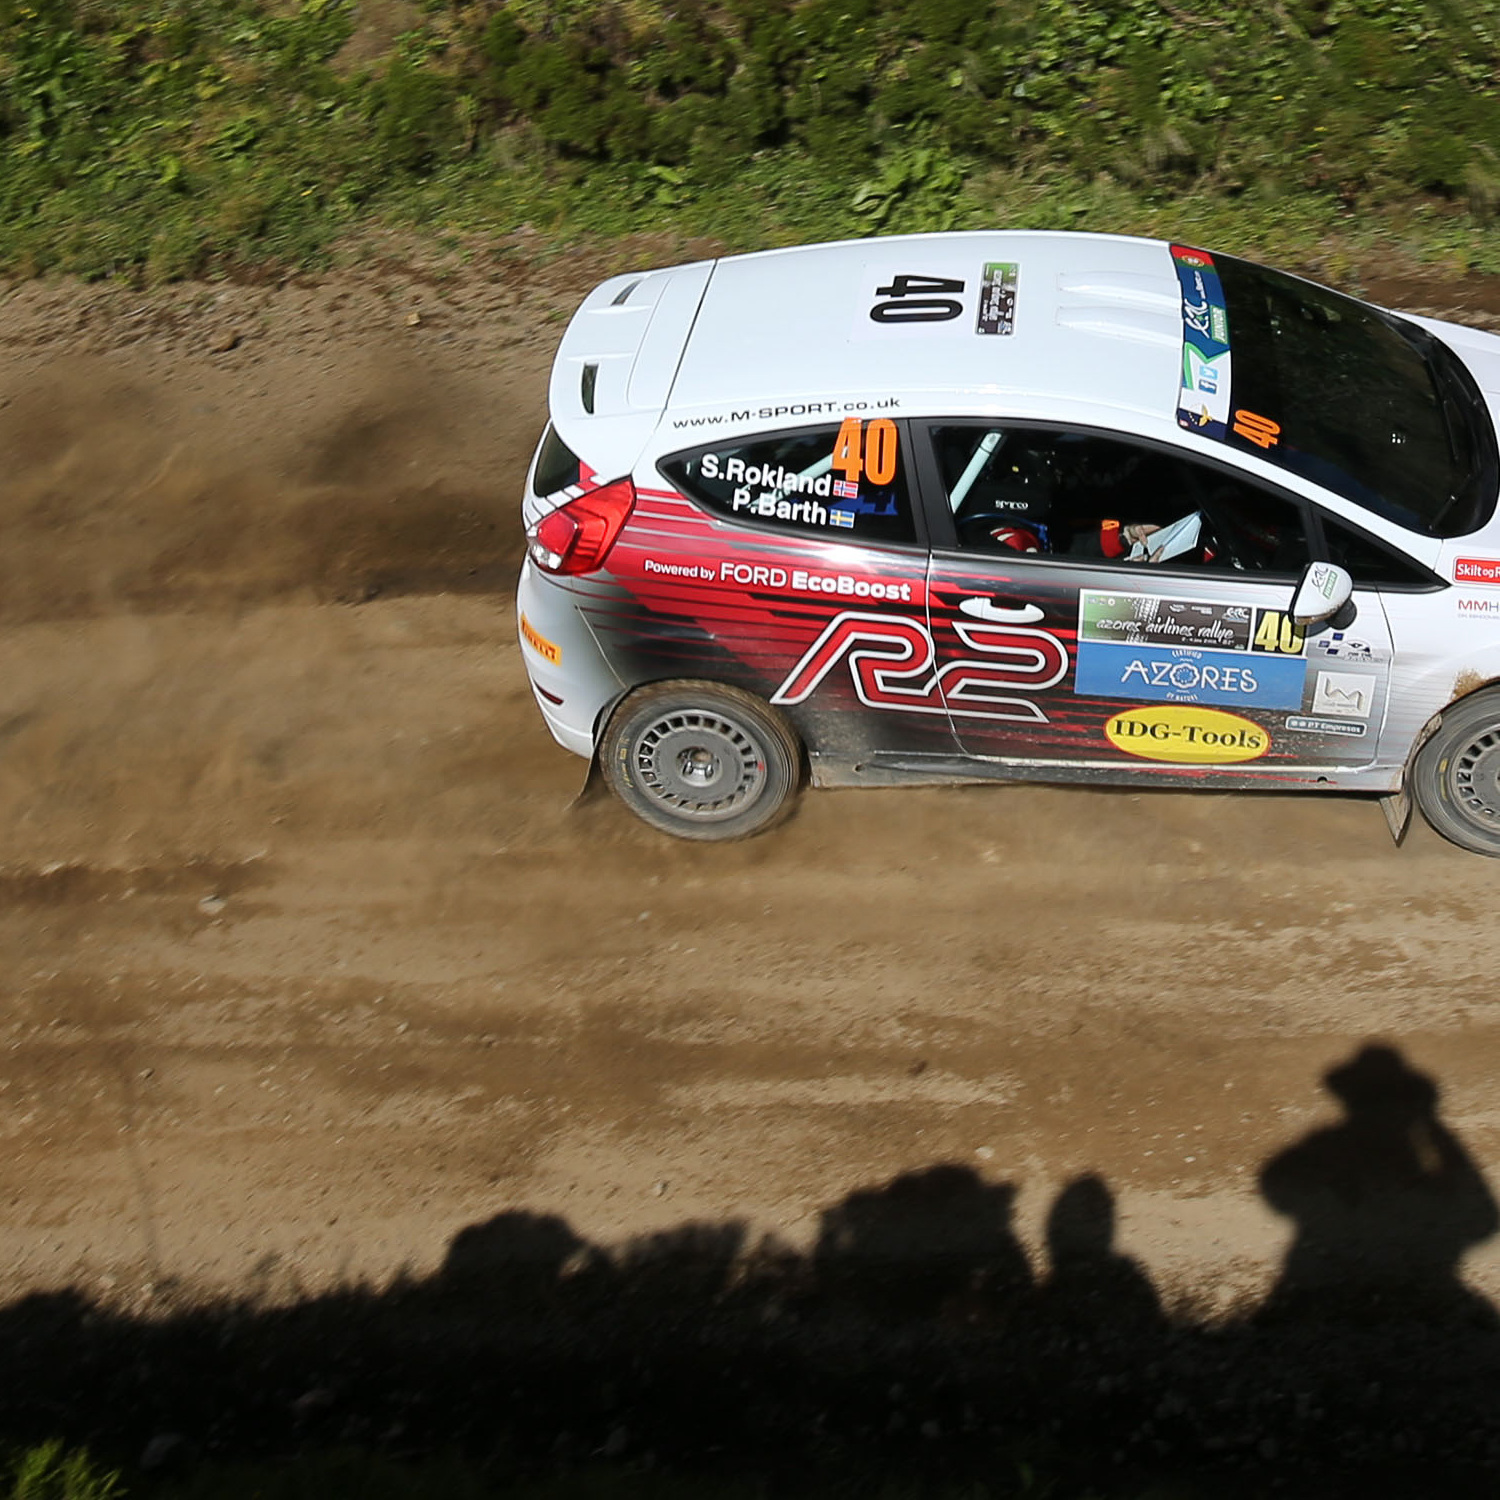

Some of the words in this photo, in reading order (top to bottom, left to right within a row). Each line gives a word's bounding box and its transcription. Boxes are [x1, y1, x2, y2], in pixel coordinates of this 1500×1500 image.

[870, 275, 965, 323] 40
[673, 397, 901, 429] www.M-SPORT.co.uk
[1233, 409, 1281, 449] 40
[831, 417, 898, 485] 40
[700, 453, 831, 497] S.Rokland
[731, 487, 828, 526] P.Barth
[644, 558, 699, 578] Powered
[700, 565, 716, 581] by
[719, 561, 787, 588] FORD
[791, 570, 912, 602] EcoBoost
[1096, 618, 1141, 632] azores
[1145, 616, 1194, 638] airlines
[1197, 619, 1235, 641] rallye
[1255, 611, 1304, 653] 40
[1120, 659, 1258, 693] AZORES
[1112, 718, 1262, 749] IDG-Tools
